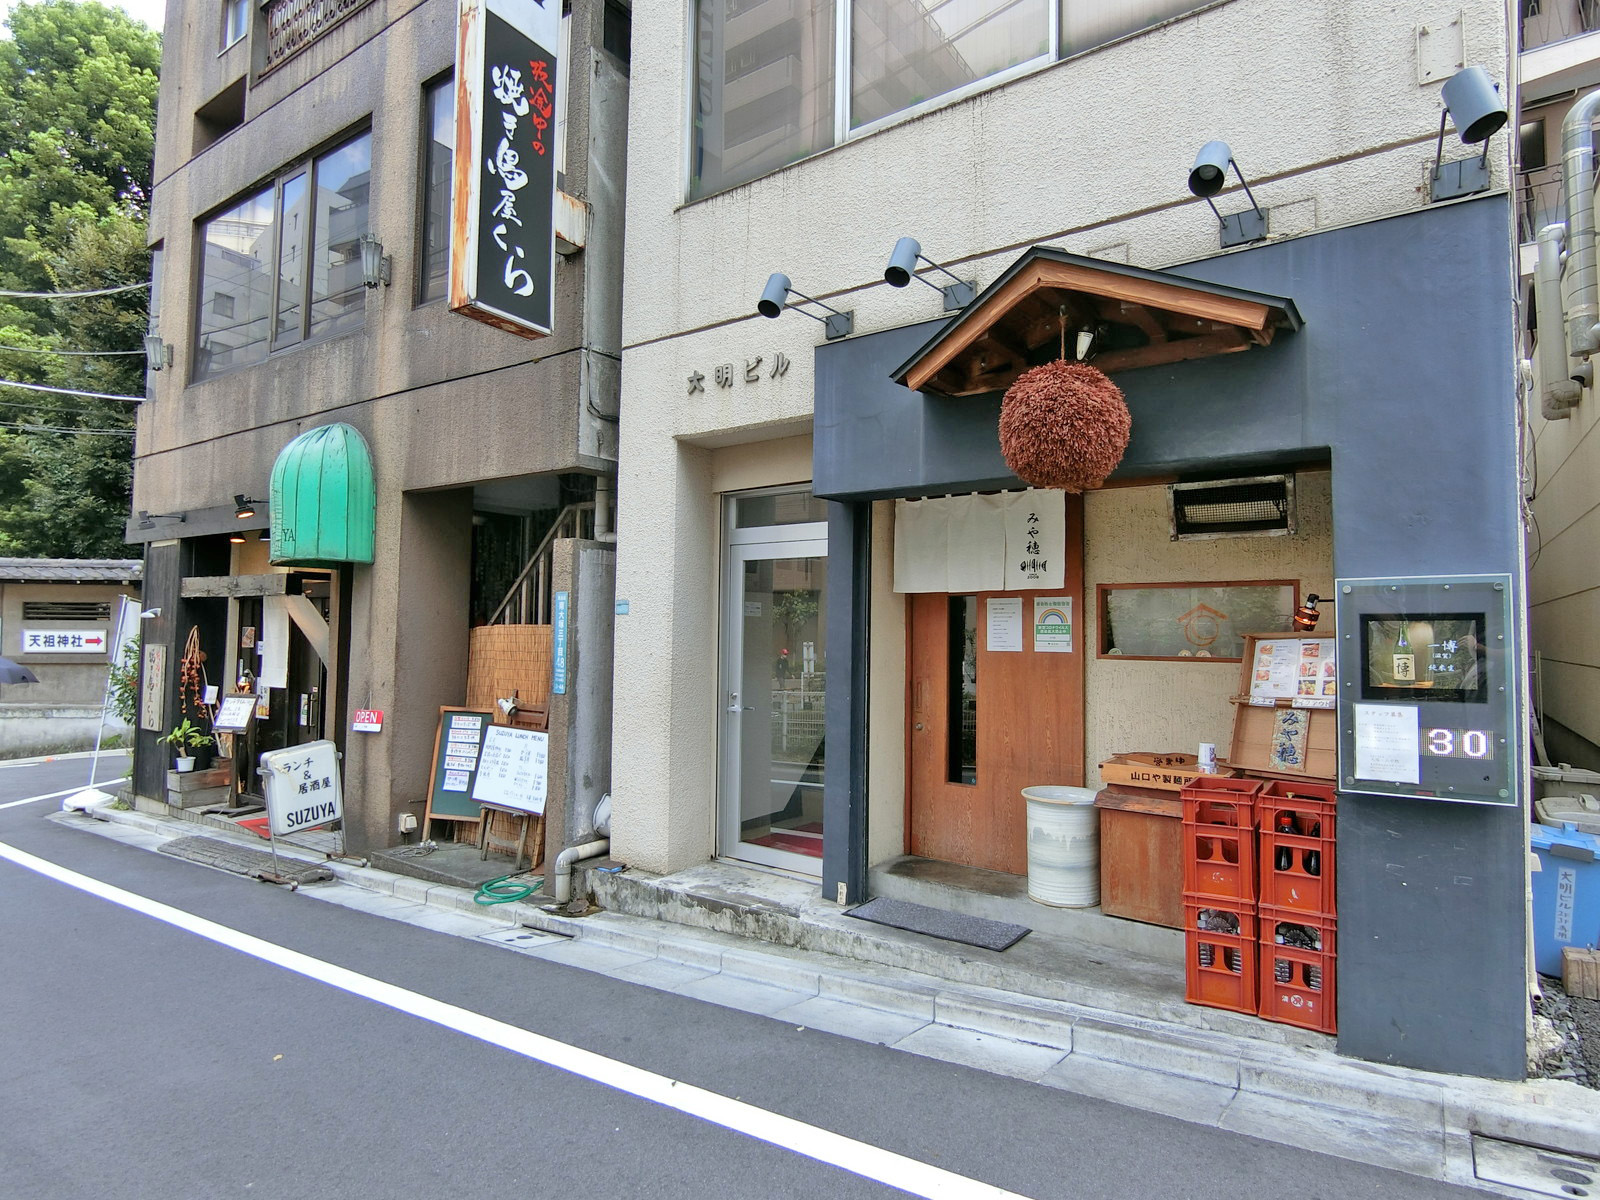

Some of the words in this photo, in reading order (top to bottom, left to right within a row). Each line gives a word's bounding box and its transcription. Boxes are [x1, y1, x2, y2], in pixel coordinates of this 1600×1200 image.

[687, 352, 791, 395] 大明ビル
[1026, 512, 1041, 555] みや穂
[29, 634, 83, 648] 天祖神社
[1427, 640, 1458, 653] 一博
[1396, 656, 1410, 678] 一博
[355, 711, 378, 723] OPEN
[1276, 711, 1299, 765] みや穂
[1428, 728, 1488, 757] 30
[283, 757, 314, 773] ランチ
[303, 770, 312, 780] &
[298, 776, 332, 795] 居酒屋
[286, 801, 335, 828] SUZUYA
